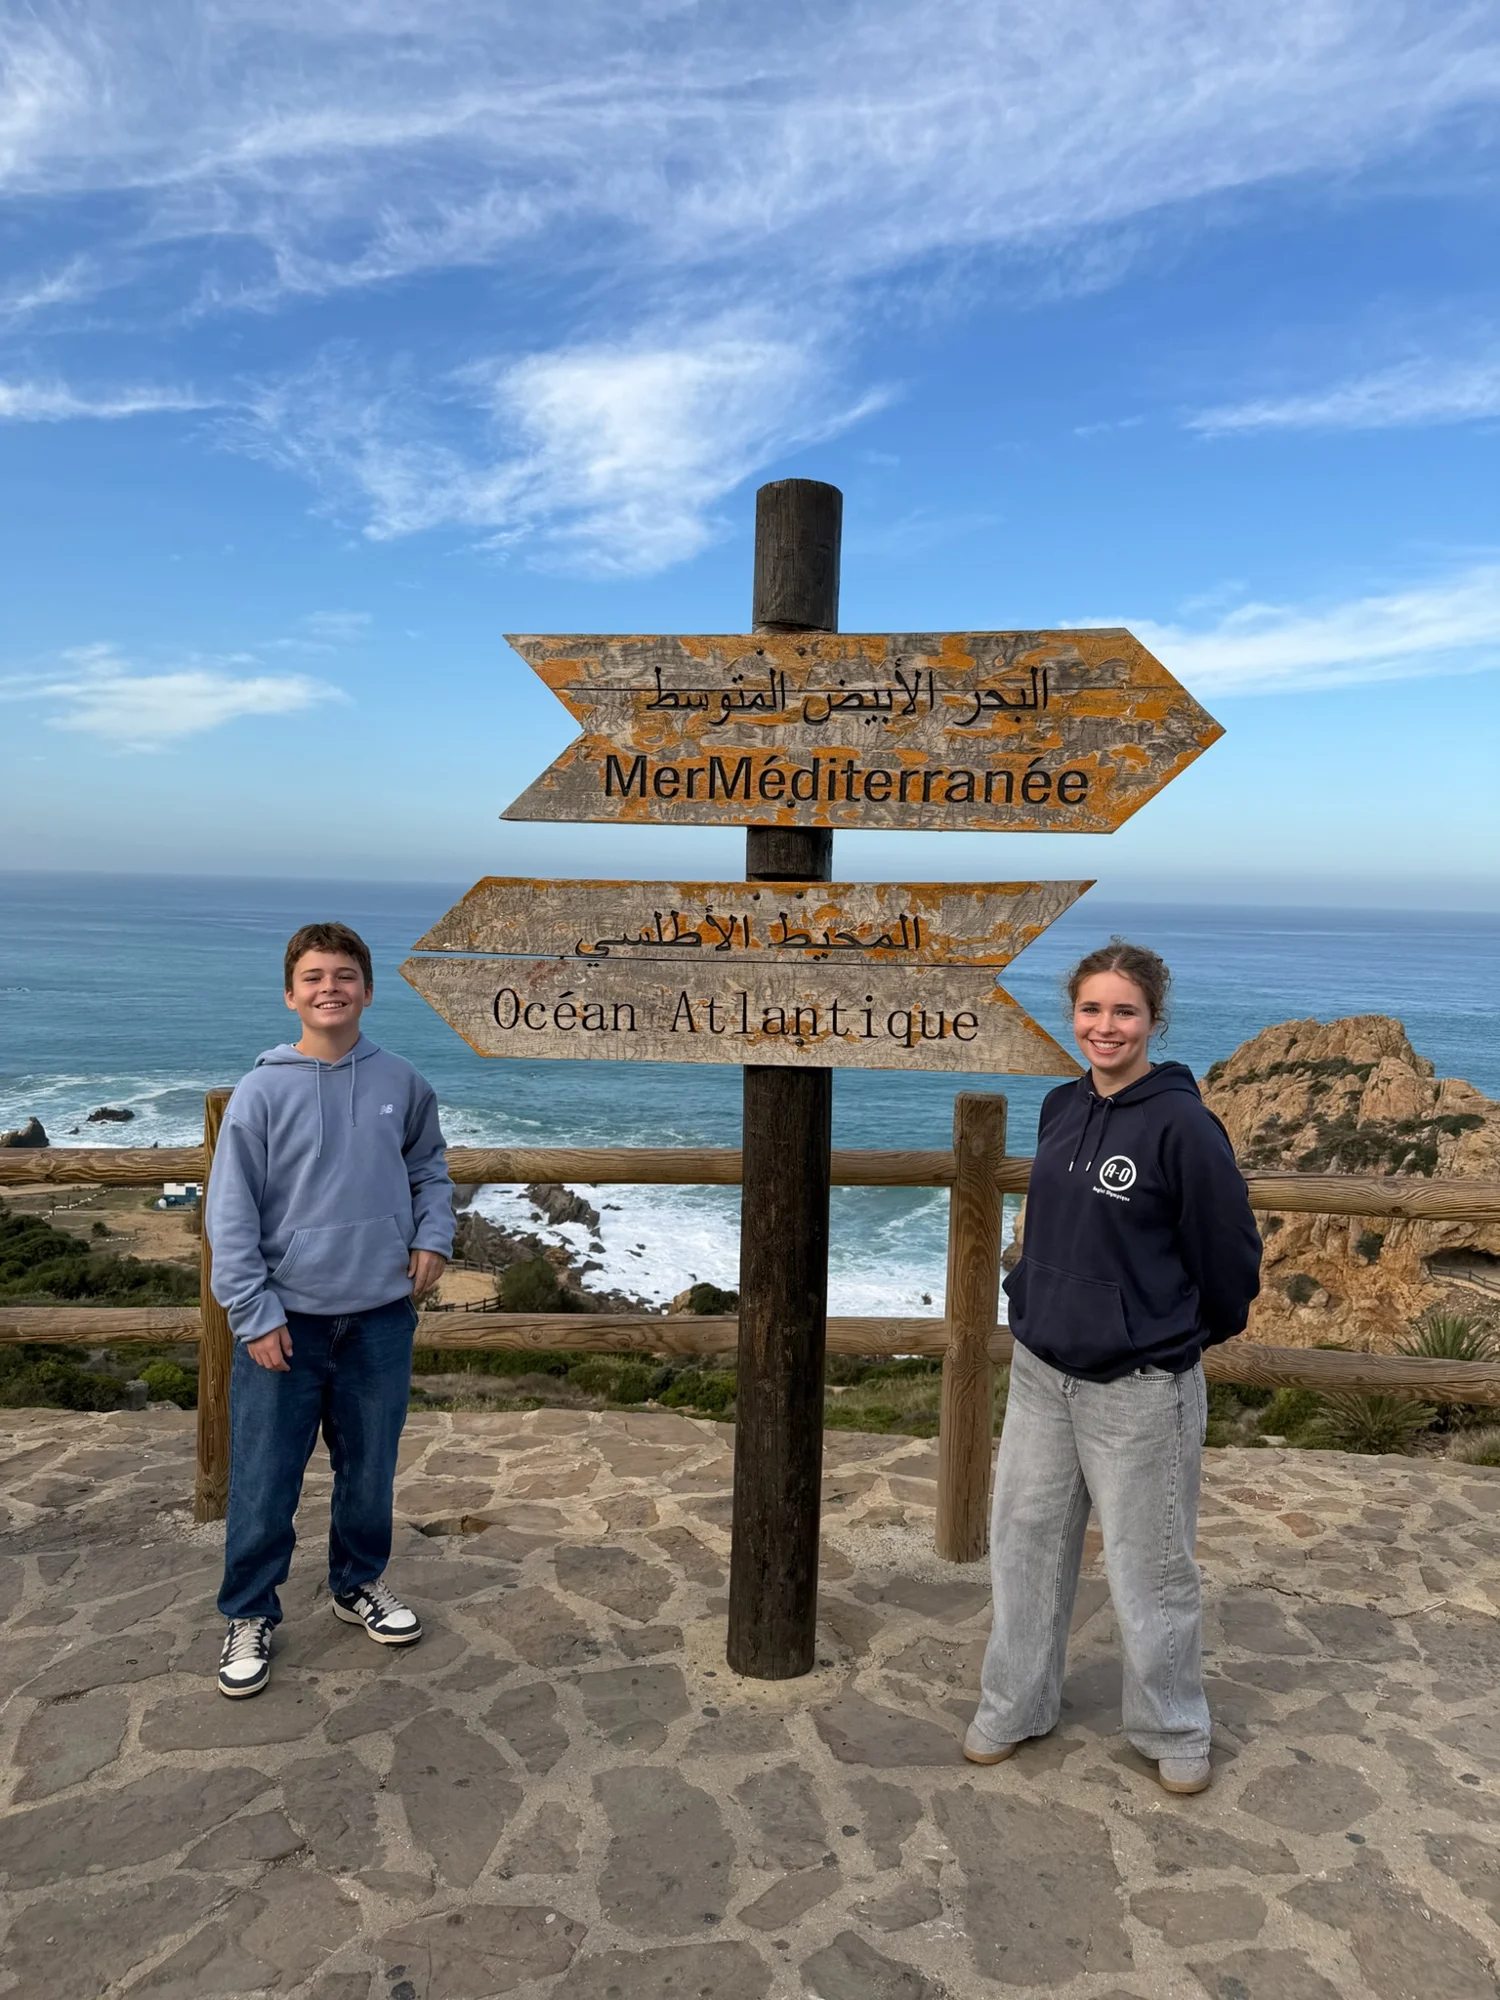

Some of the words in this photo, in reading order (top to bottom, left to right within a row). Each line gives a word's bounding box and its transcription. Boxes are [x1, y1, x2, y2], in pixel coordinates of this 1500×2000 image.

[646, 666, 786, 726] المتوسط
[803, 657, 934, 726] الأبيض
[953, 666, 1047, 726] البحر
[574, 904, 749, 968] الأطلسي
[768, 911, 920, 962] المحيط
[493, 987, 638, 1033] Océan
[669, 990, 979, 1049] Atlantique
